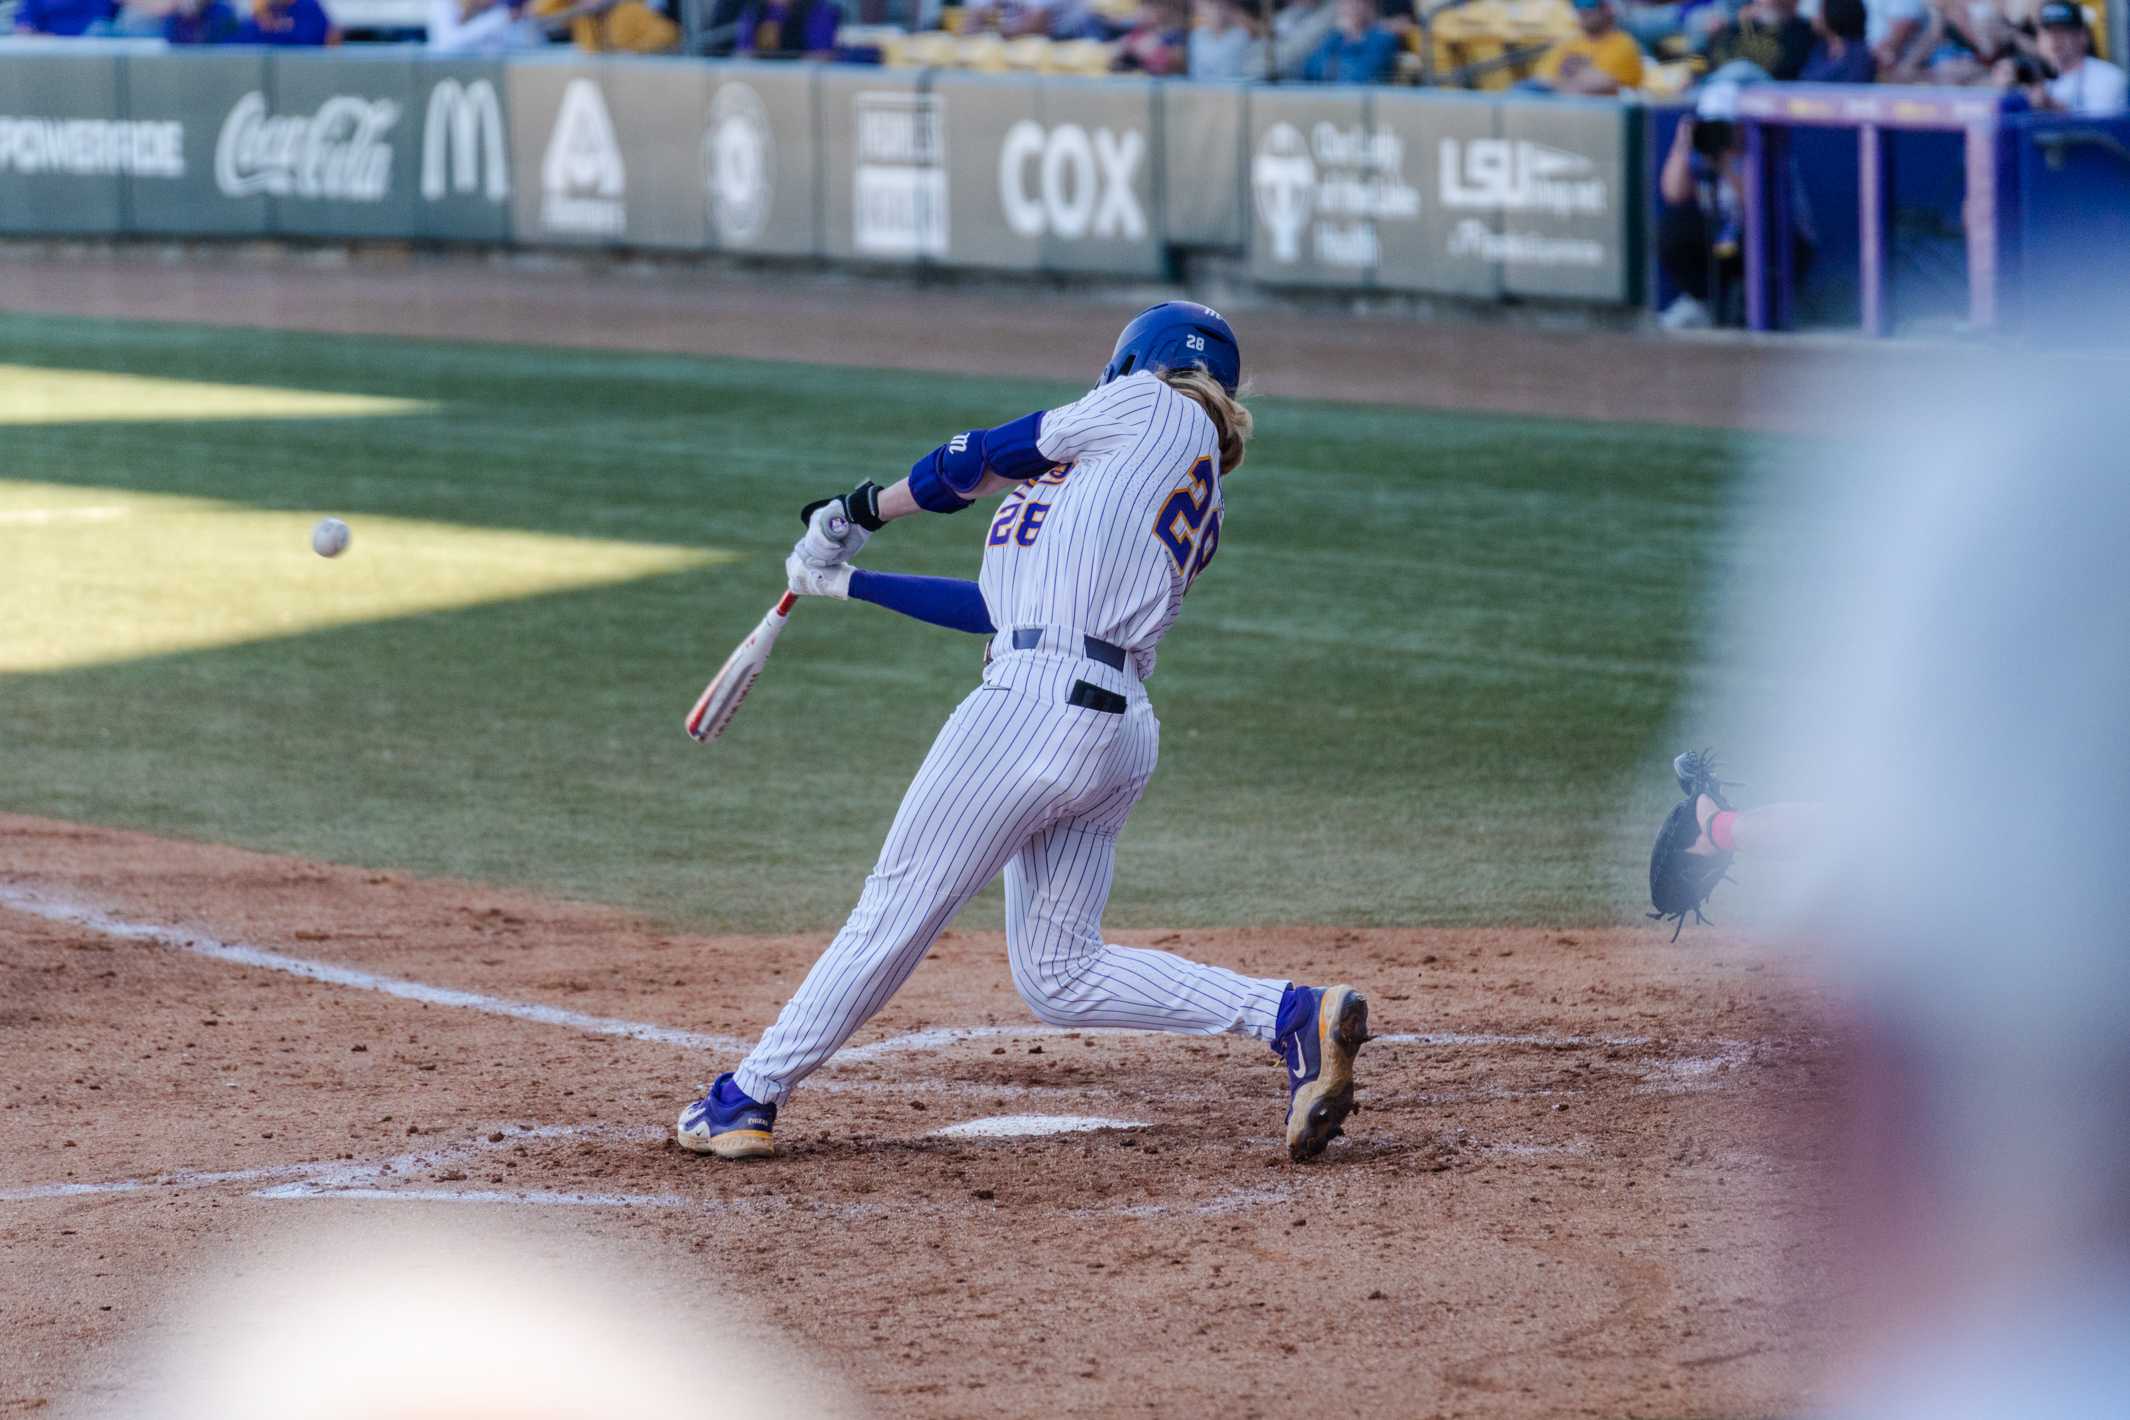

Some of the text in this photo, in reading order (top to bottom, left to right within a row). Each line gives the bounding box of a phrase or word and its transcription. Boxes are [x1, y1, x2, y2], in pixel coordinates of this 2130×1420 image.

[999, 121, 1147, 240] COX
[1438, 137, 1536, 209] LSU
[1186, 334, 1205, 351] 28
[988, 501, 1054, 546] 28
